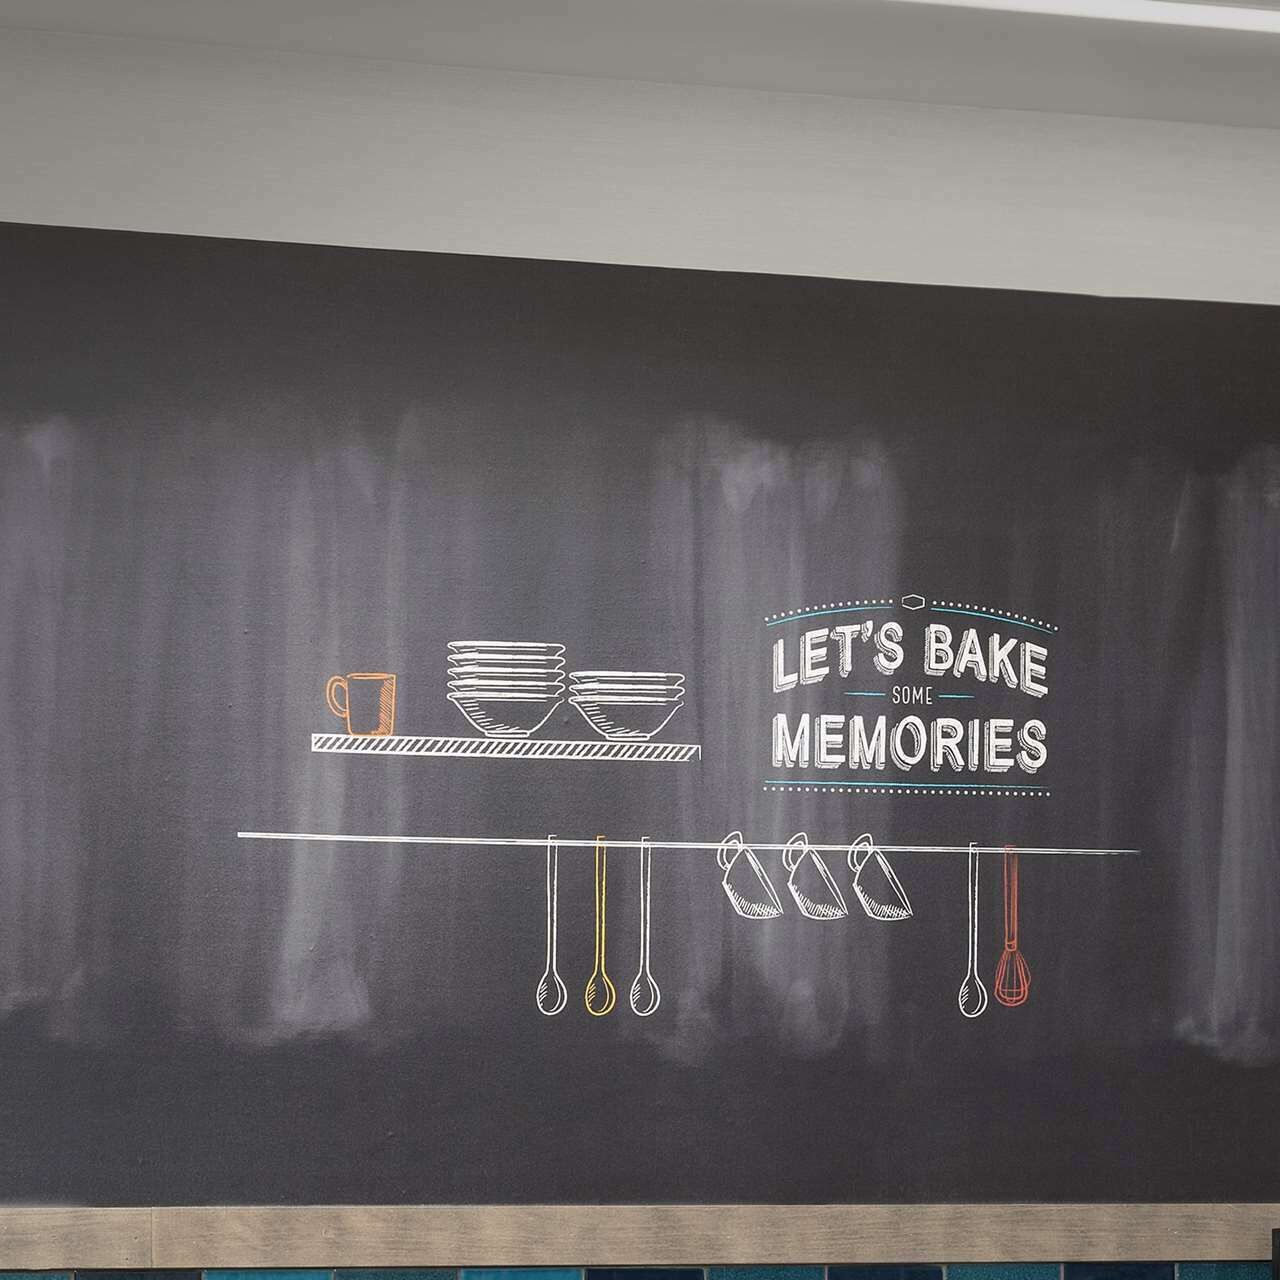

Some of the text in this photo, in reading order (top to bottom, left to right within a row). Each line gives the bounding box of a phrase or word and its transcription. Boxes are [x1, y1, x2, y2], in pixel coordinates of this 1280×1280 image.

[772, 620, 1049, 698] LET'S BAKE
[892, 684, 933, 706] SOME
[771, 711, 1049, 774] MEMORIES
